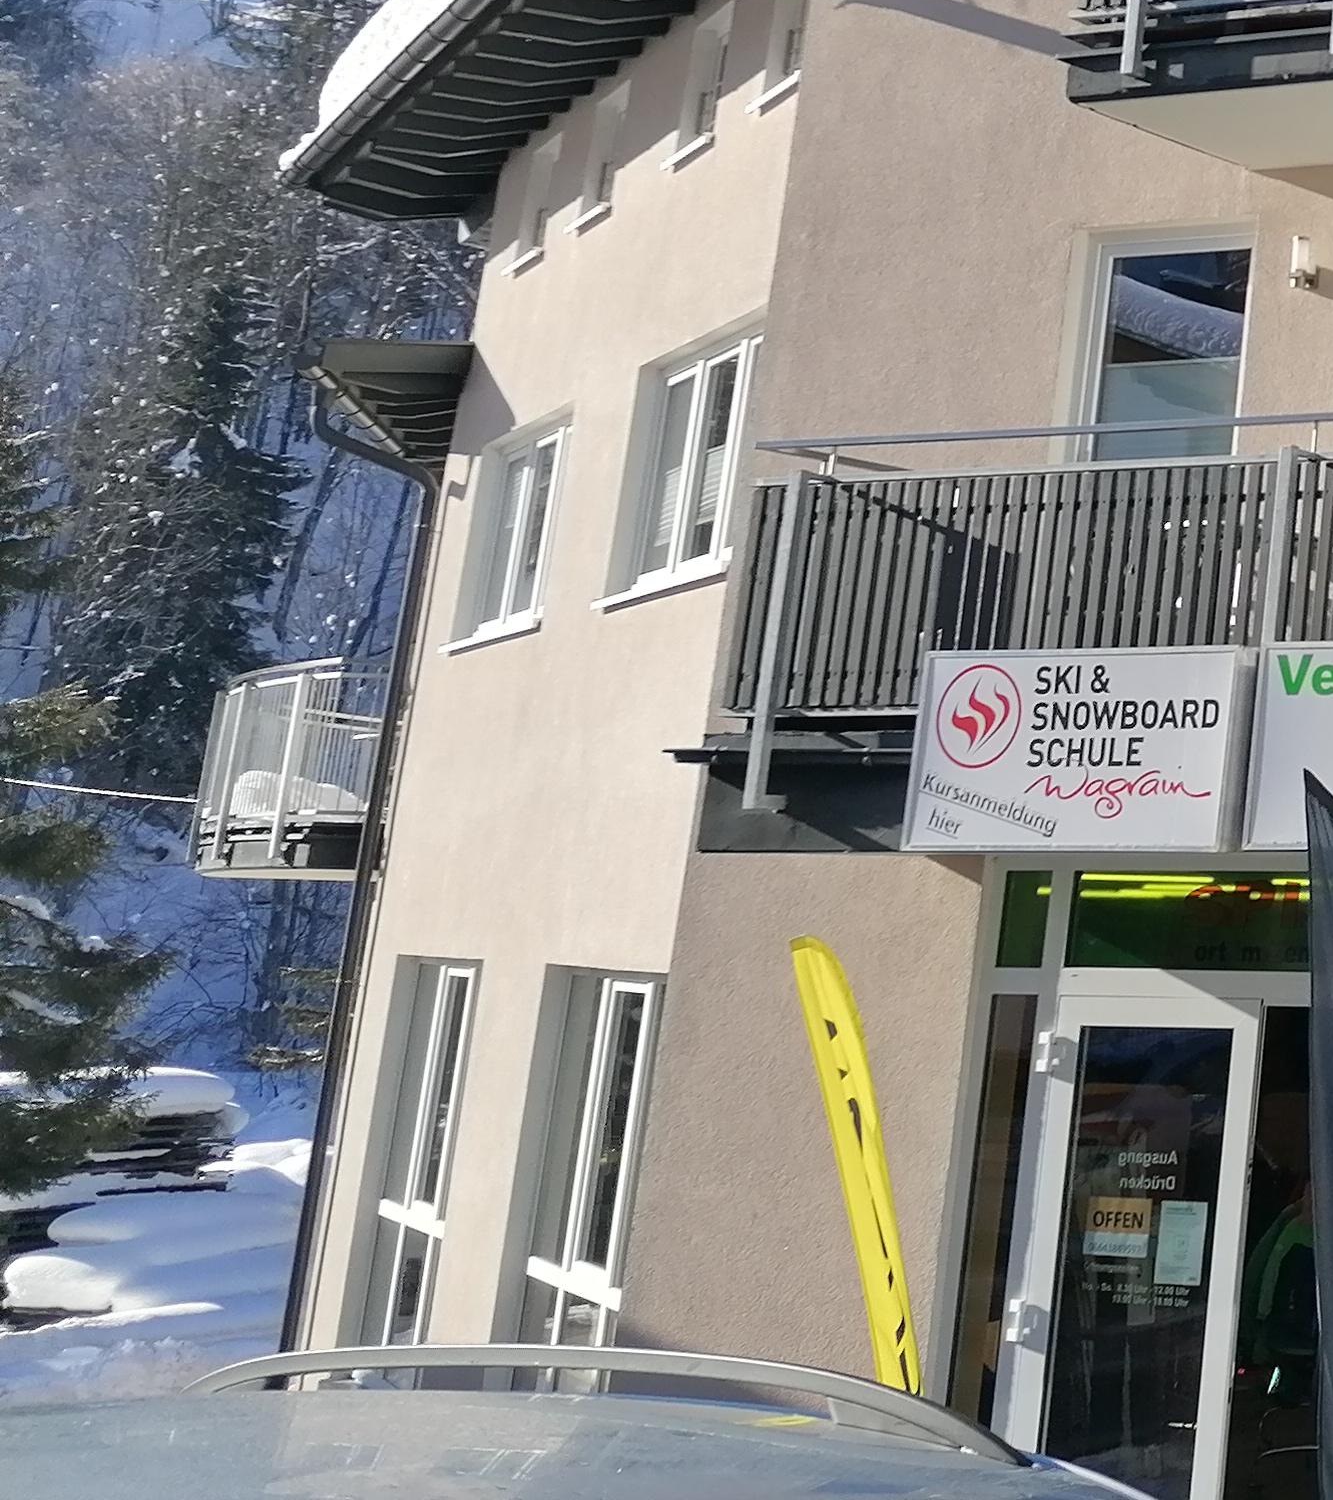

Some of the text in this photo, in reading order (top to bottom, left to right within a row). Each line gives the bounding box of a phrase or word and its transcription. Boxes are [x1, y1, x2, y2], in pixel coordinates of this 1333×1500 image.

[1034, 663, 1111, 695] SKI &
[1030, 698, 1220, 731] SNOWBOARD
[1026, 736, 1145, 768] SCHULE
[921, 772, 1058, 837] Kursanmeldung
[1023, 765, 1212, 819] Wagrain
[928, 807, 963, 837] hier
[1092, 1210, 1145, 1229] OFFEN
